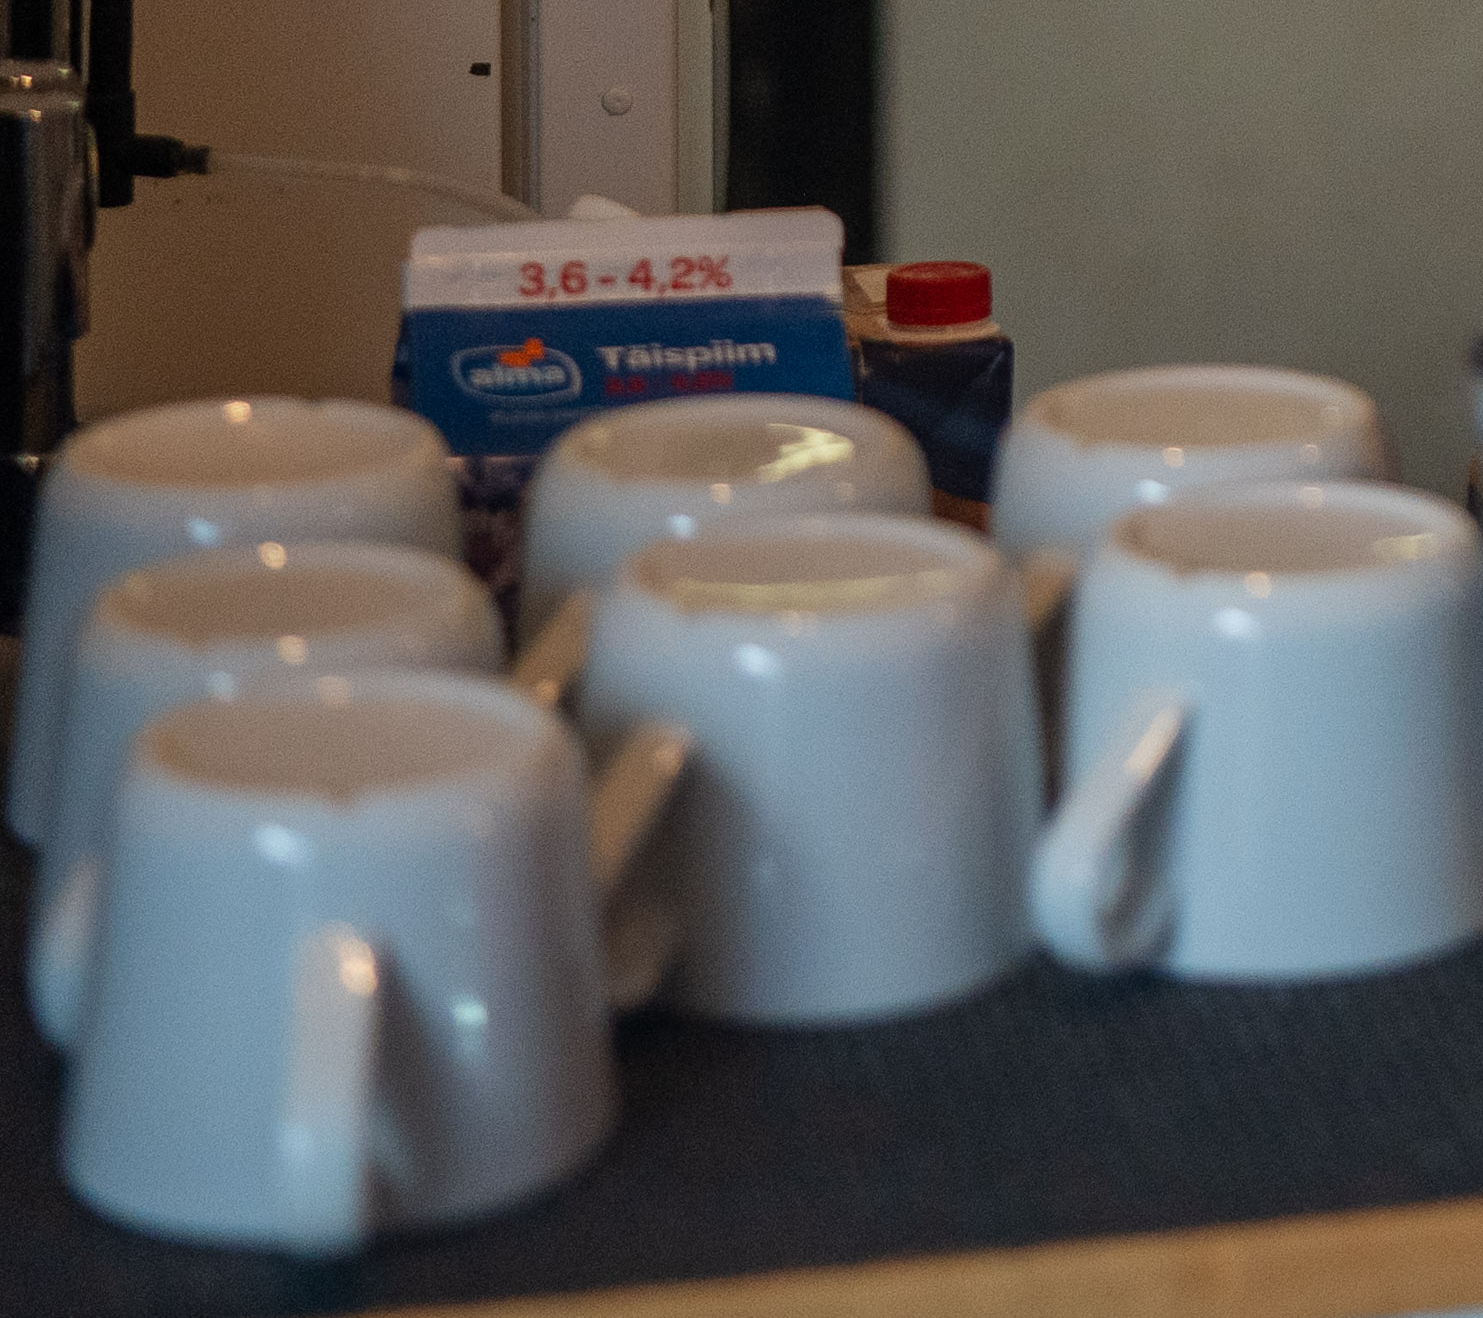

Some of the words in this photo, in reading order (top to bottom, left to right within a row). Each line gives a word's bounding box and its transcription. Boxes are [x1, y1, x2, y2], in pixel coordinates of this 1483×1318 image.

[518, 260, 588, 302] 3,6
[627, 254, 734, 299] 4,2%
[596, 338, 777, 374] Täispiim
[469, 361, 567, 390] alma
